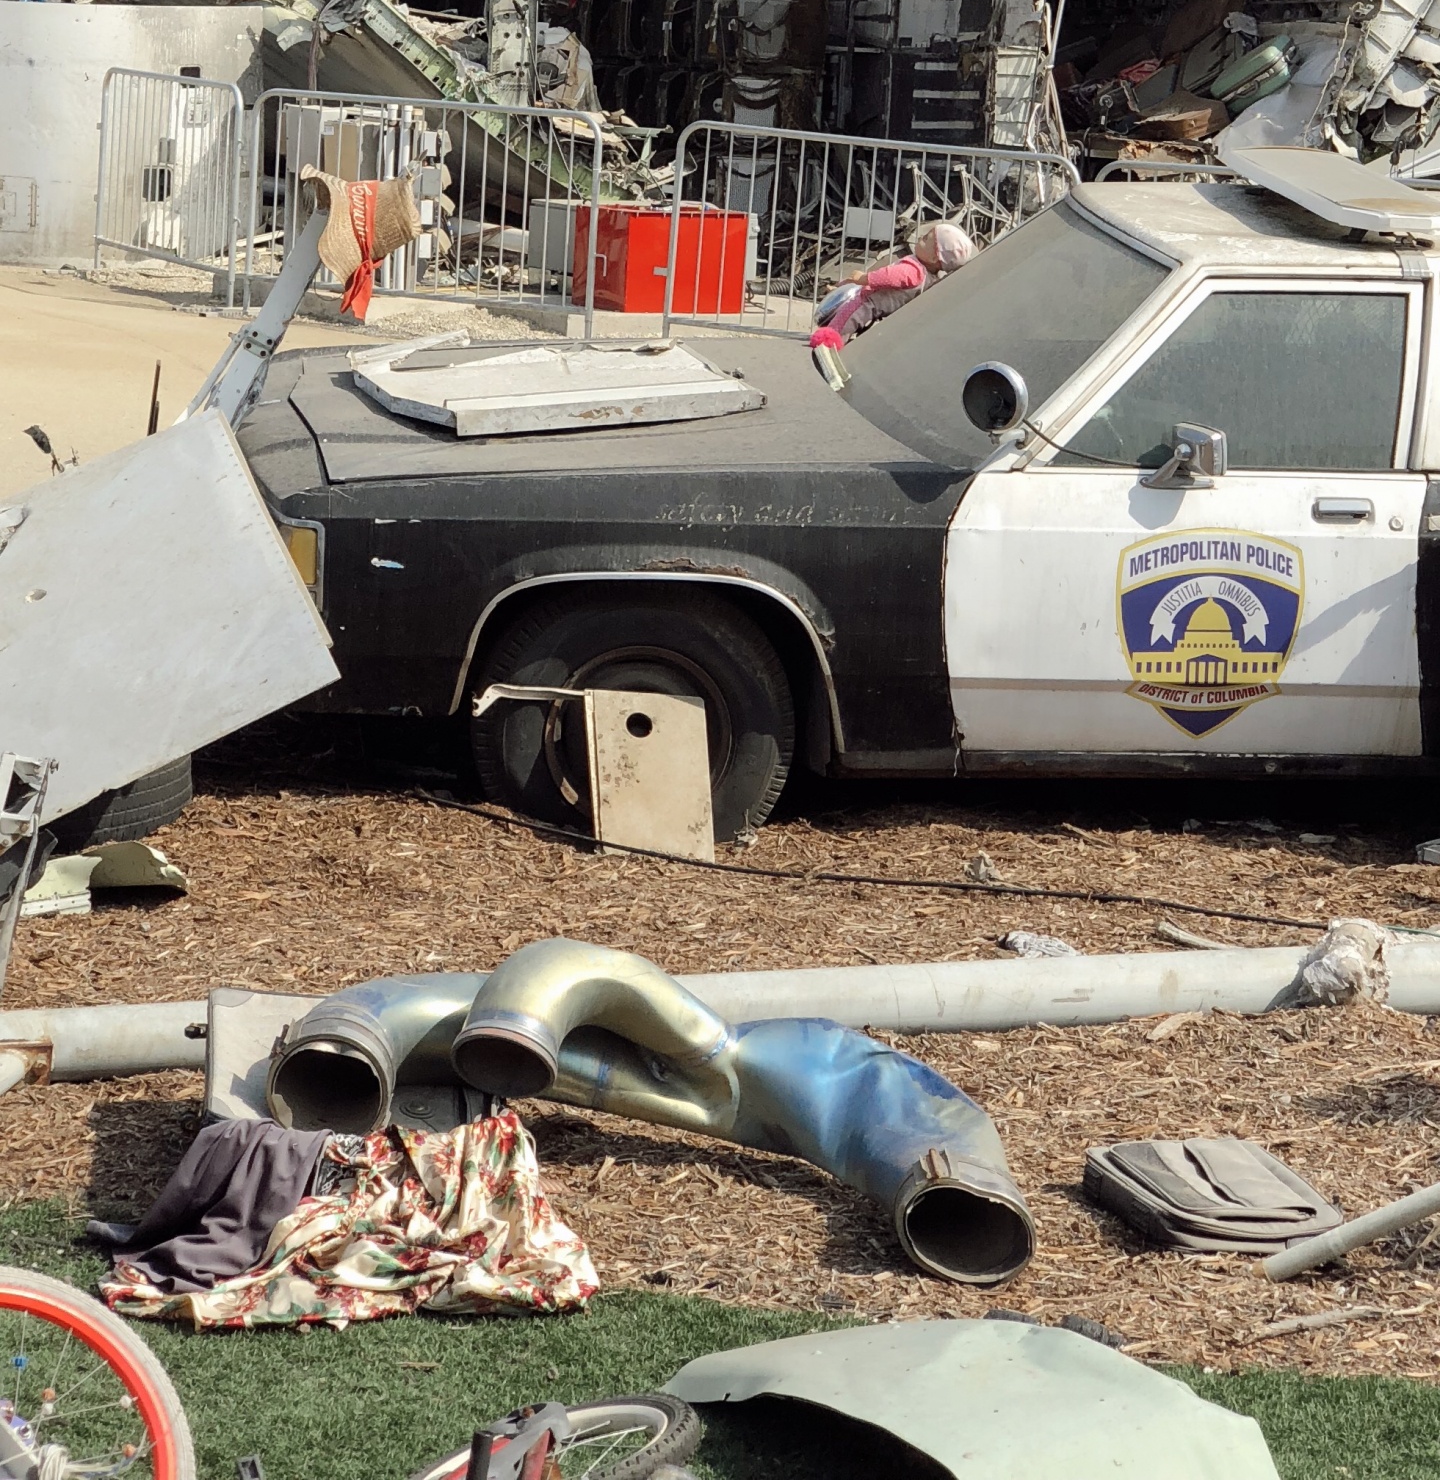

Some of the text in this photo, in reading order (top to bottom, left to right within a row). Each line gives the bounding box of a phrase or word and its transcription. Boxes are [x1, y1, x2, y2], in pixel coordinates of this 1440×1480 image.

[1130, 540, 1293, 577] METROPOLITAN POLICE
[1161, 581, 1203, 616] JUSTITIA
[1218, 580, 1261, 617] OMNIBUS
[1138, 683, 1269, 704] DISTRICT of COLUMBIA
